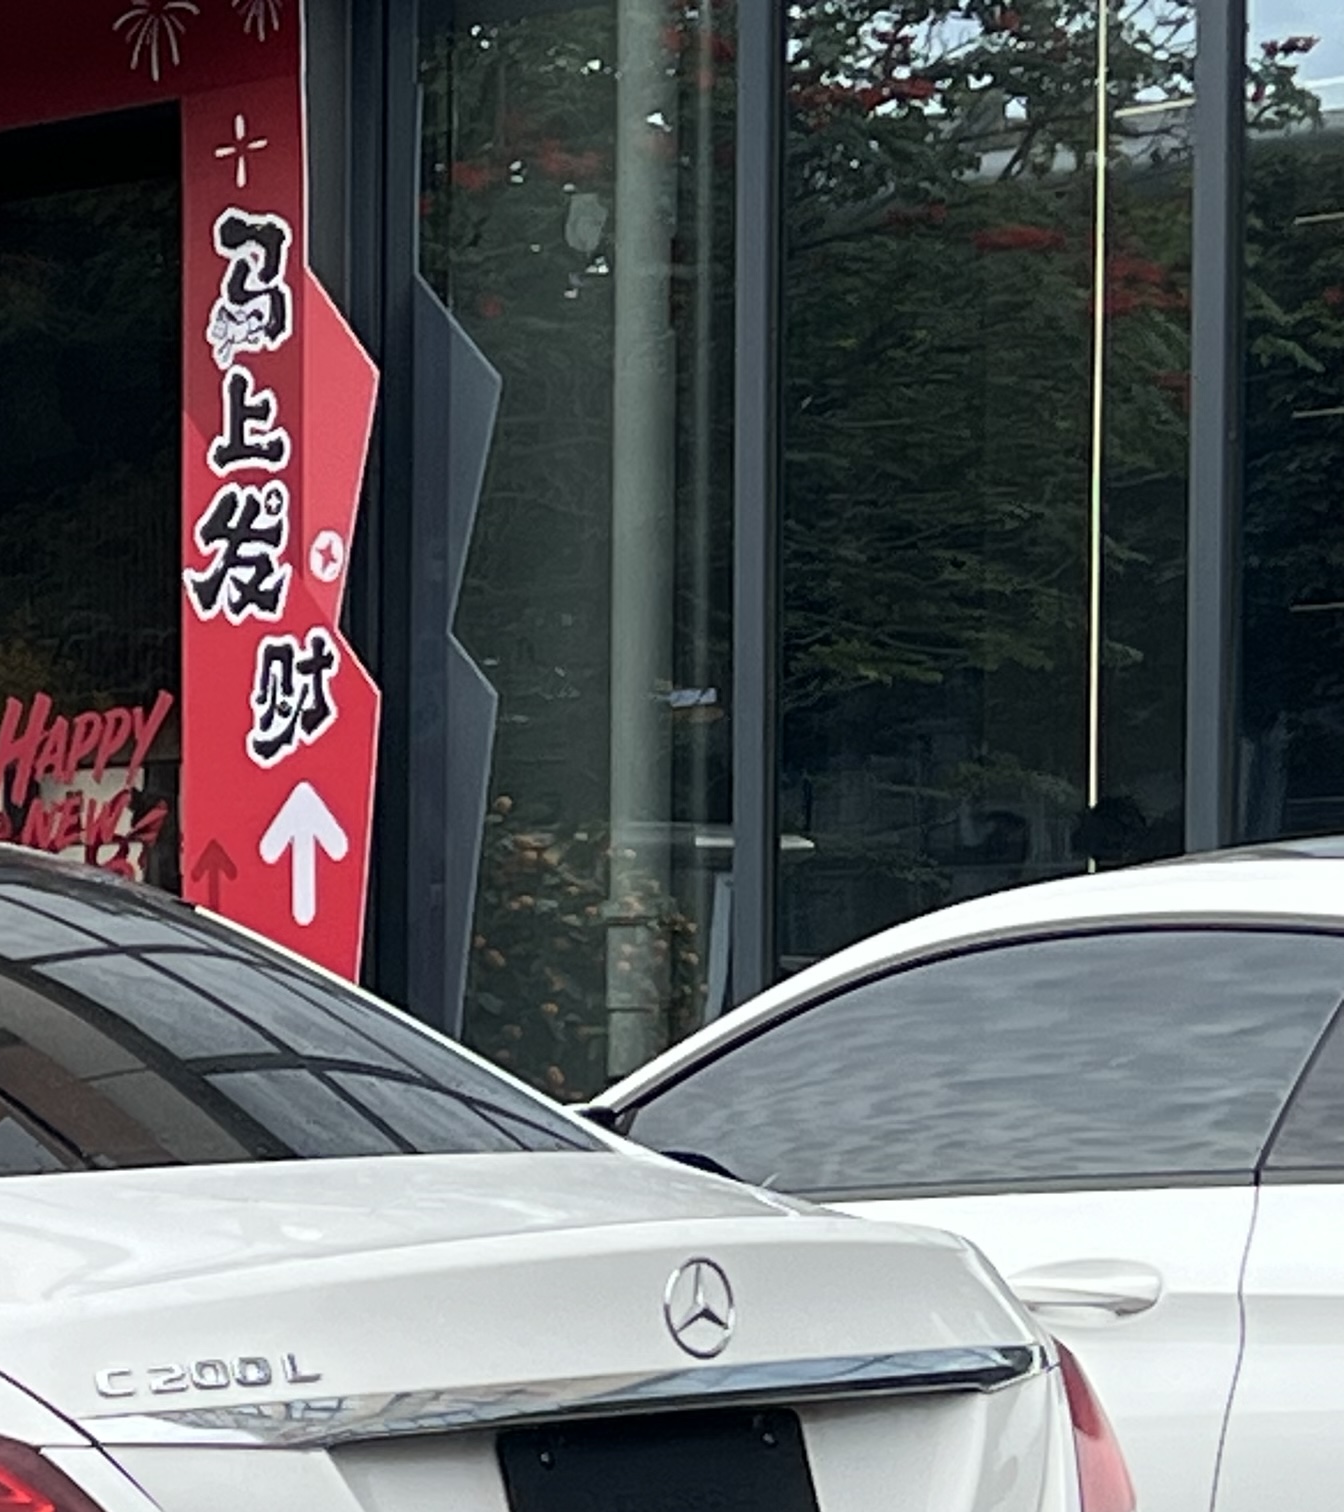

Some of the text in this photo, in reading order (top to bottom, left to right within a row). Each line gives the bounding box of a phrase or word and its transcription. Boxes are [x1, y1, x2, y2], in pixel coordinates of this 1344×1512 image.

[185, 209, 338, 768] 马上发财
[94, 1352, 322, 1398] C 200 L
